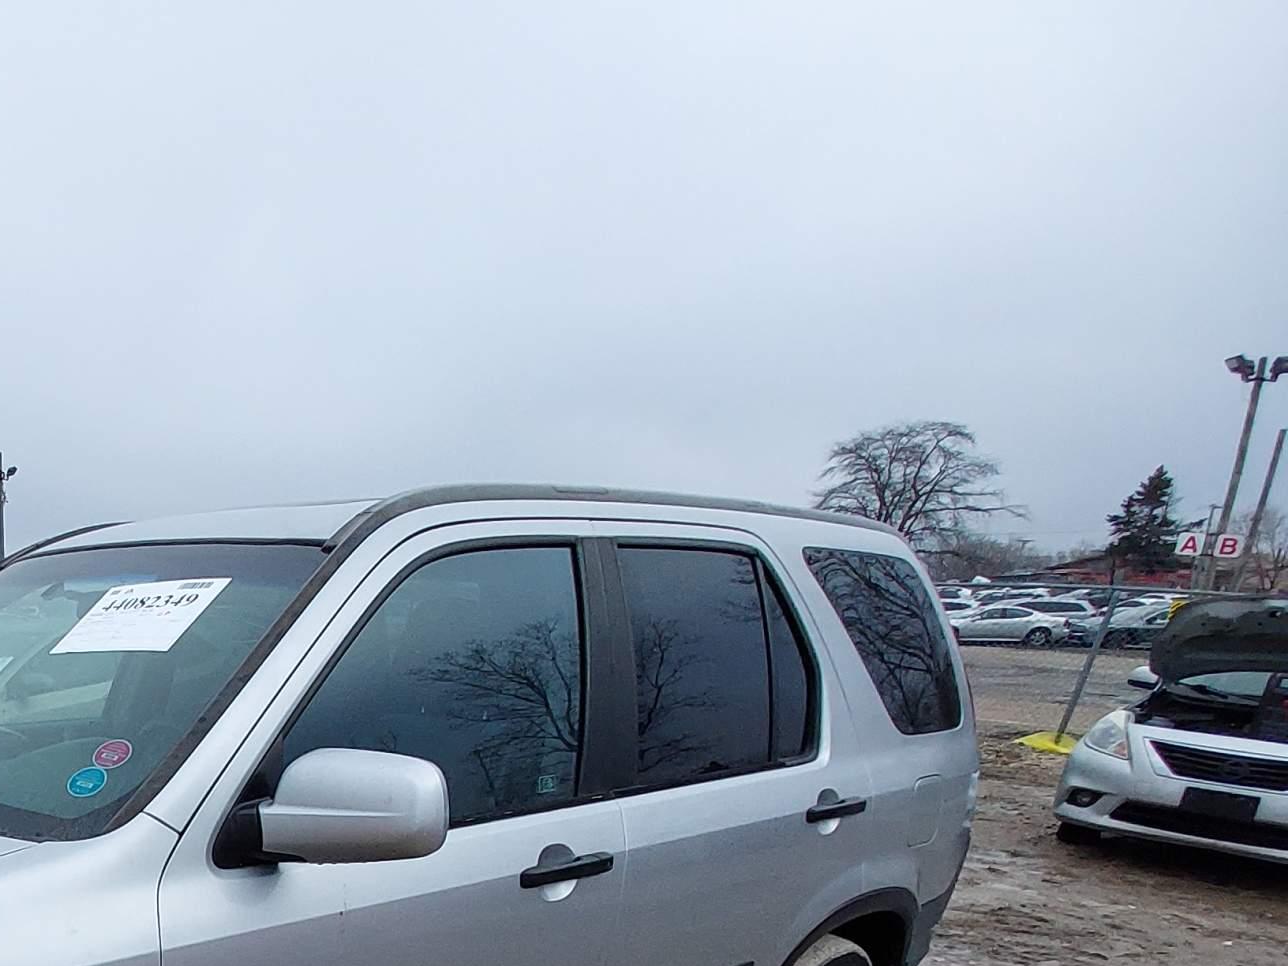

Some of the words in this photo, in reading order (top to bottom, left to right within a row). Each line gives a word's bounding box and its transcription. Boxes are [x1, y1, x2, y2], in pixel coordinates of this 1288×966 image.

[1179, 535, 1197, 553] A
[1219, 537, 1238, 555] B
[101, 593, 200, 612] 44082349
